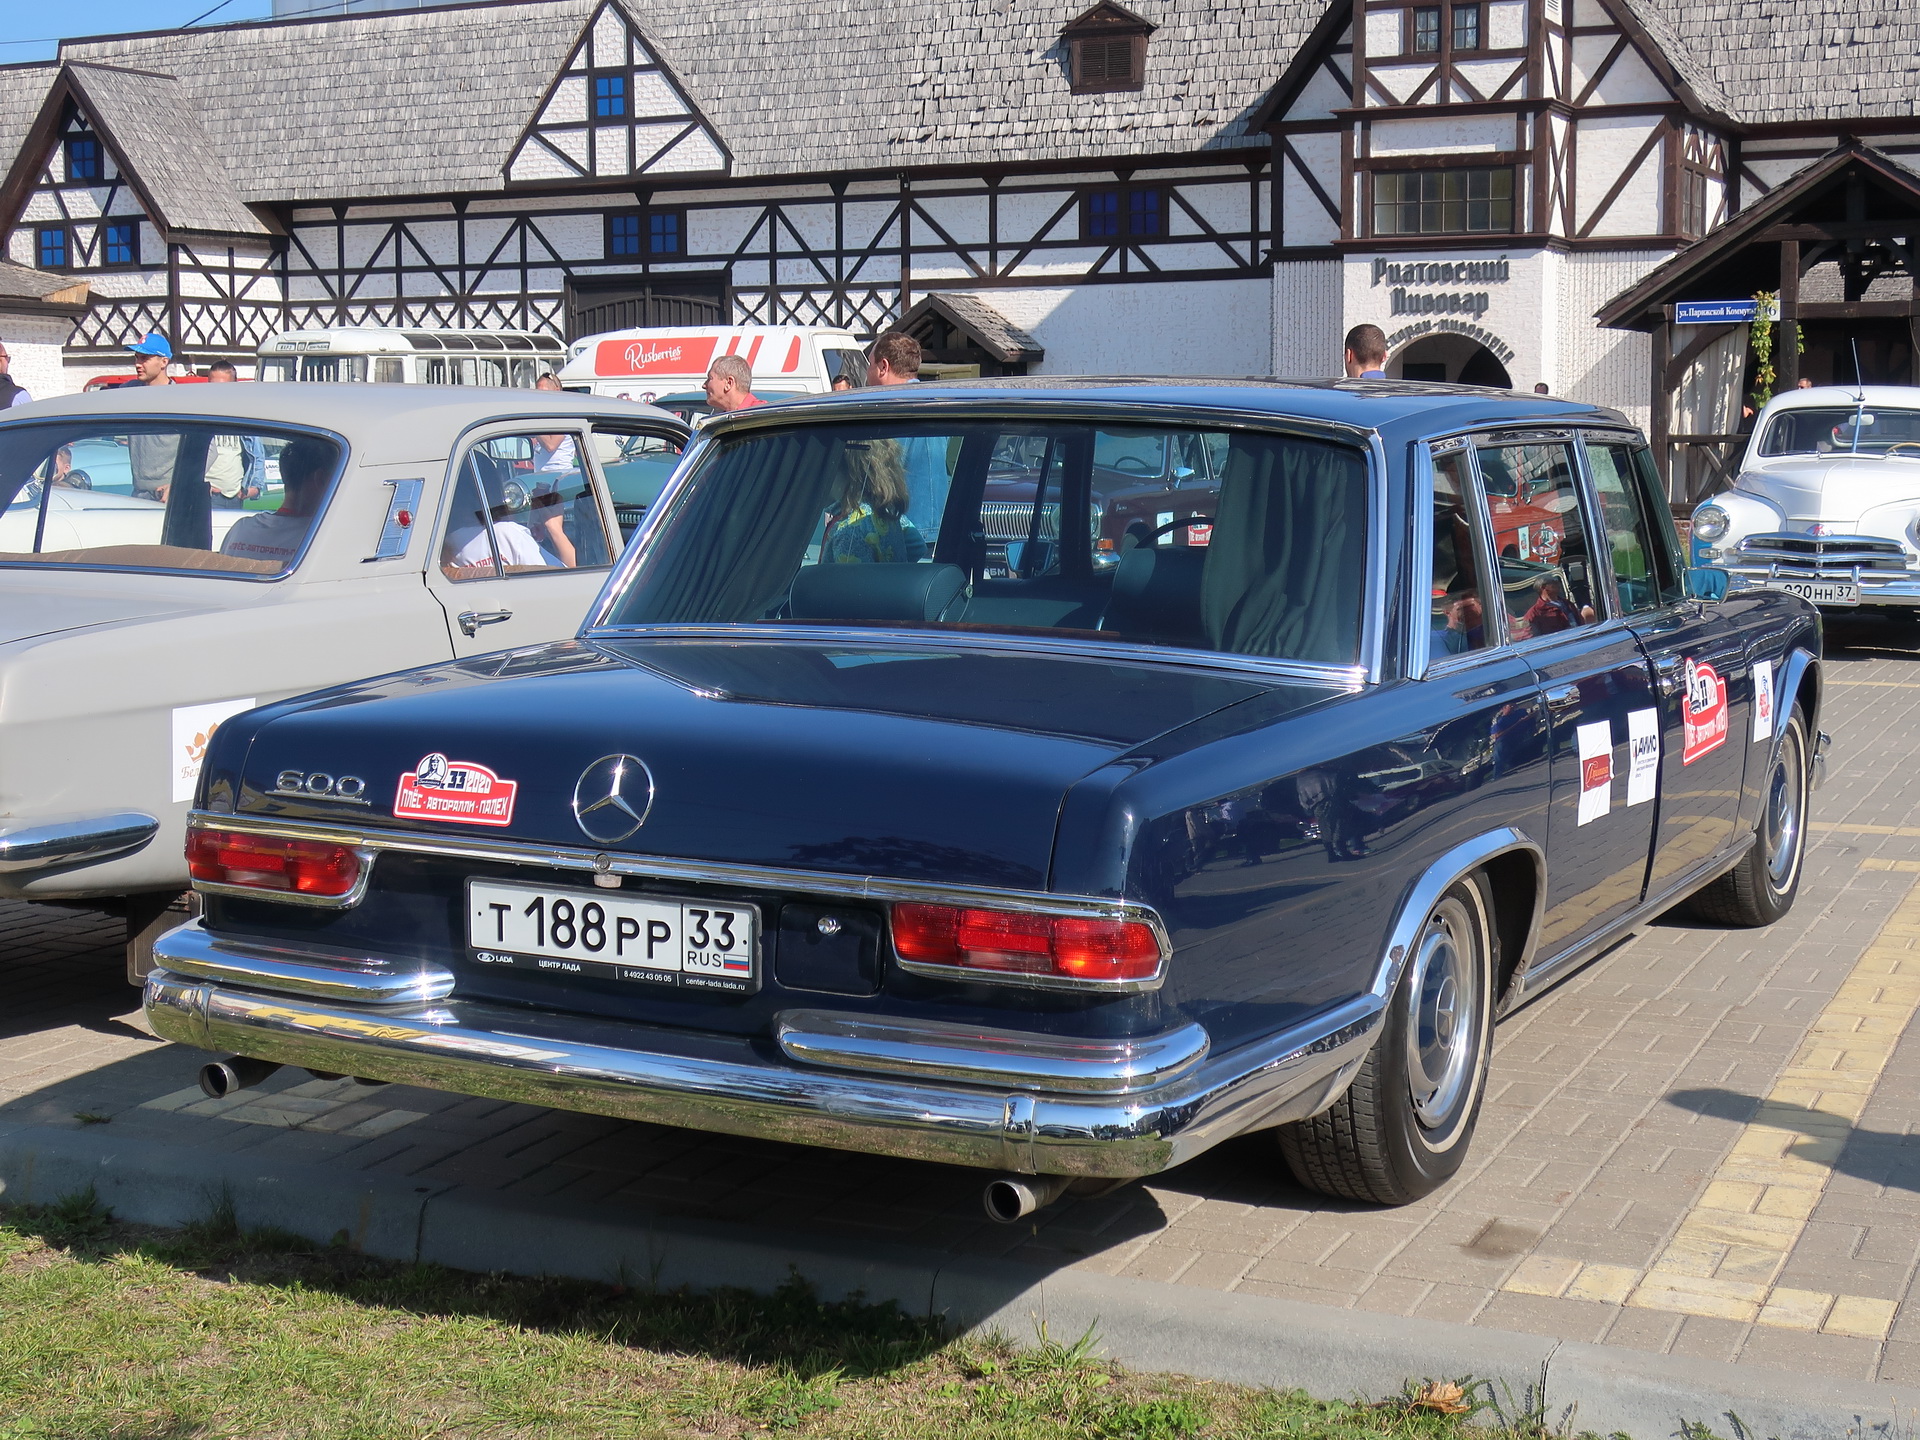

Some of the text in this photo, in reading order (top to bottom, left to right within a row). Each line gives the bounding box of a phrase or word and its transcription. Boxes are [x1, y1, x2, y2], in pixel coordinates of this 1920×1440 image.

[1371, 254, 1509, 288] Риатовский
[1390, 287, 1489, 321] Пивовар
[624, 342, 682, 371] Rusberries
[1837, 585, 1852, 598] 37
[276, 769, 366, 798] 600
[447, 769, 492, 794] 33 2020
[400, 788, 509, 815] ПЛЁС АВТОРАЛЛИ ПАЛЕХ
[688, 908, 735, 952] 33
[495, 955, 514, 964] LADA
[538, 959, 581, 972] ЦЕНТР ЛАДА
[687, 950, 722, 968] RUS
[629, 970, 645, 979] 4922
[645, 972, 654, 980] 43
[654, 973, 663, 981] 05
[663, 974, 672, 983] 05
[685, 977, 746, 991] center-lada.lada.ru
